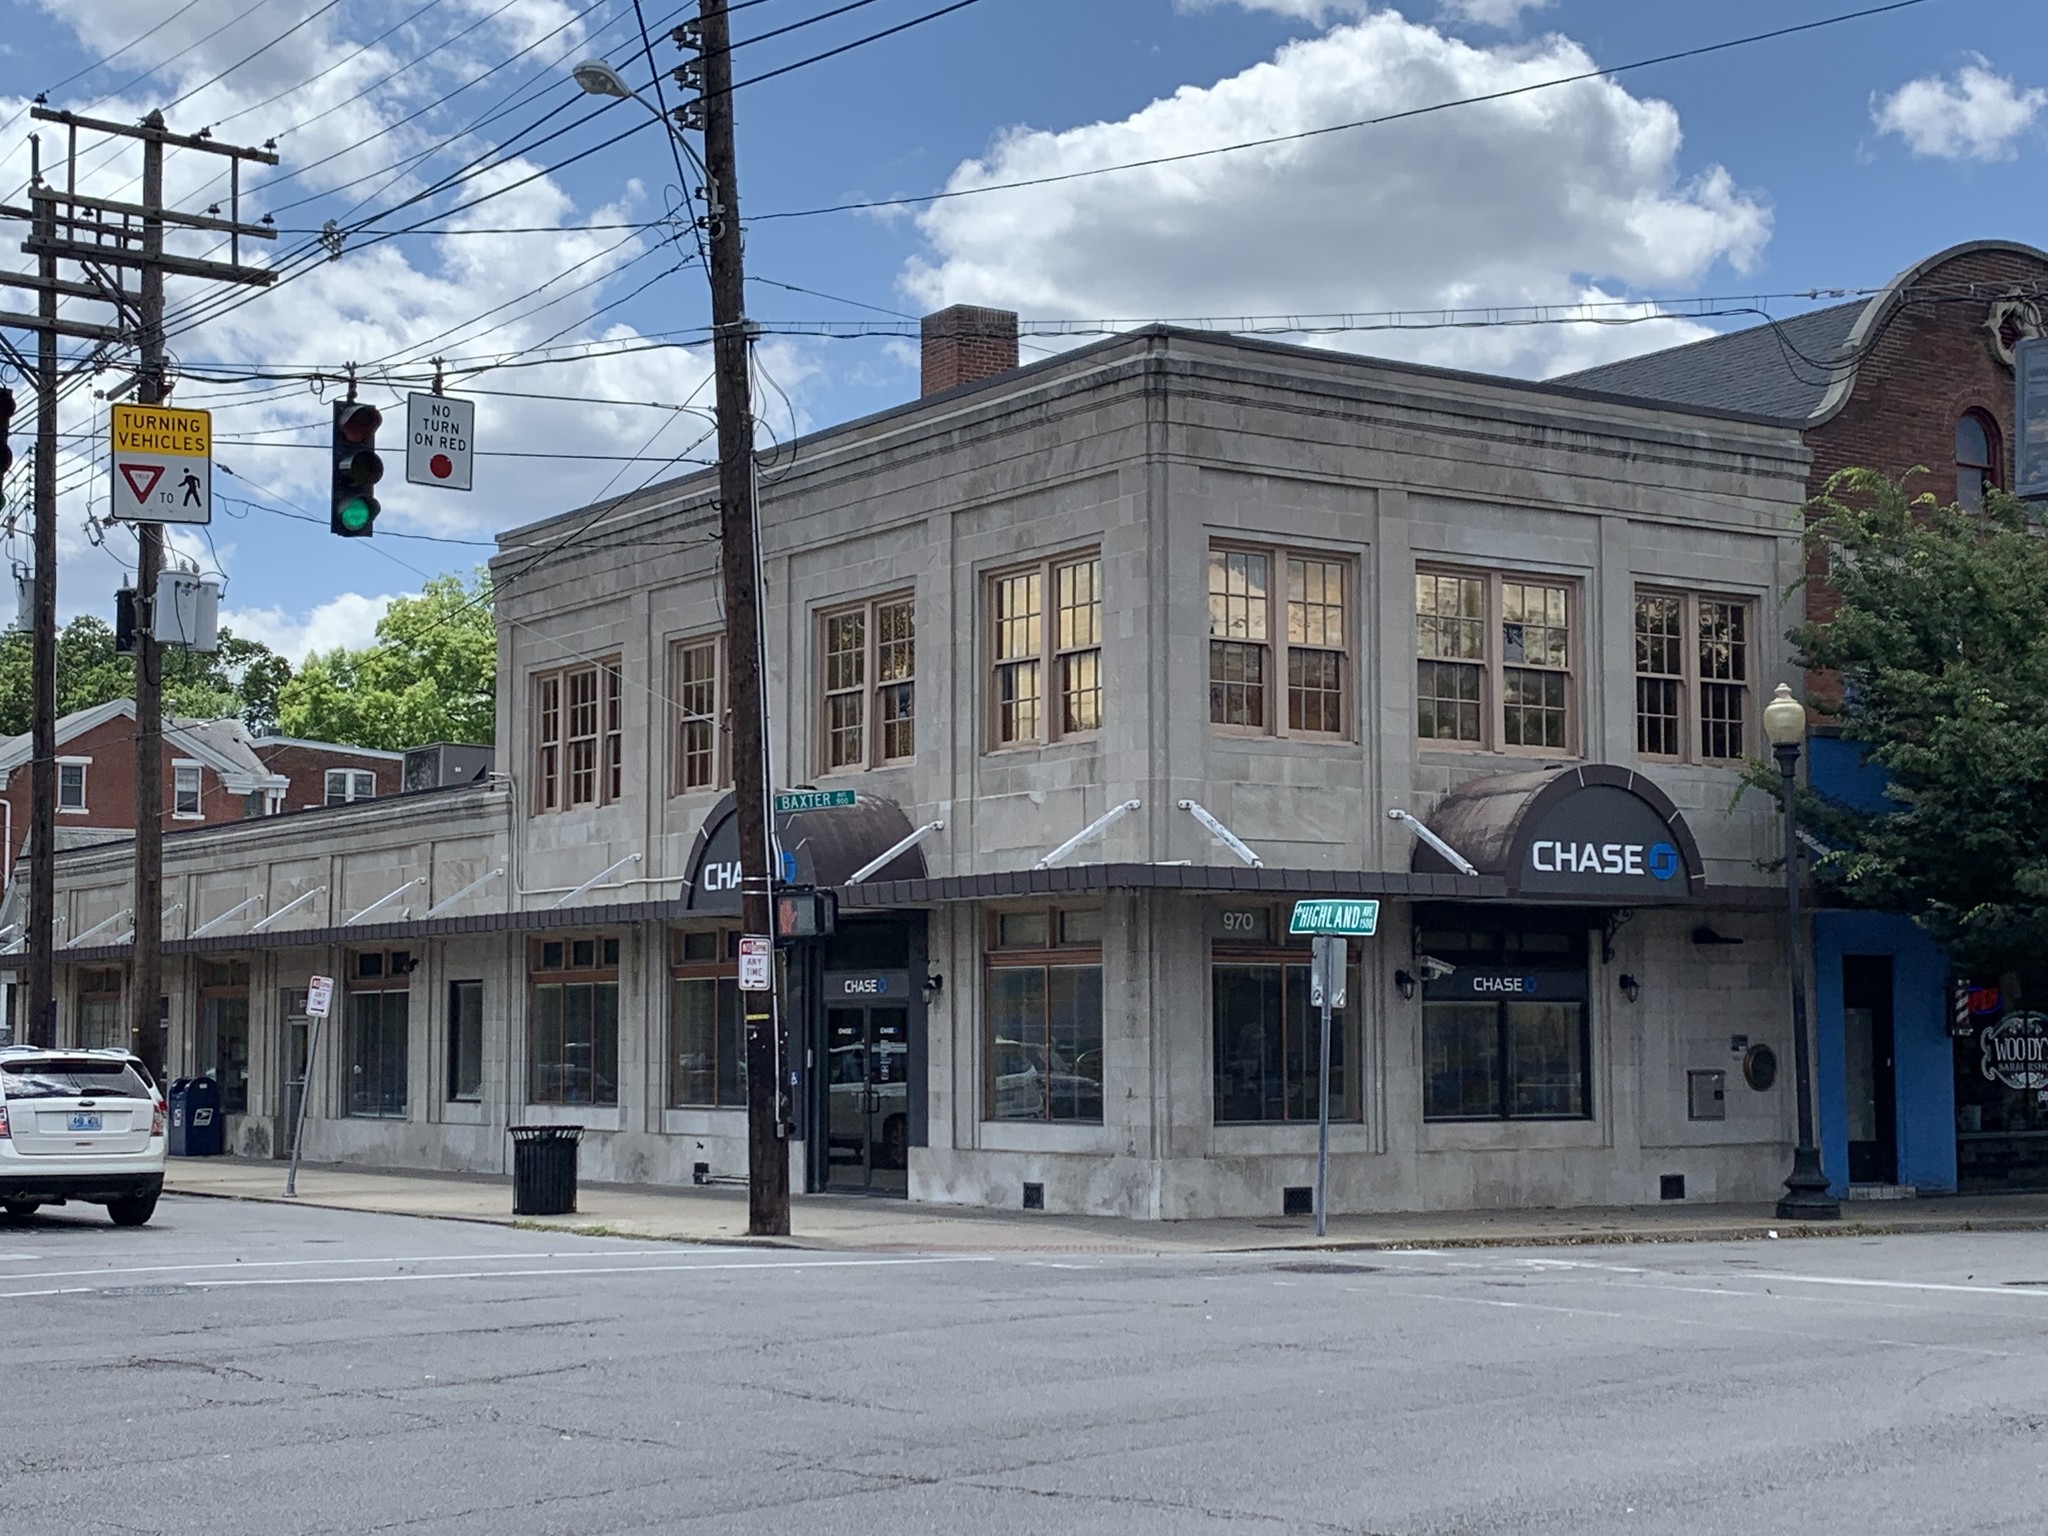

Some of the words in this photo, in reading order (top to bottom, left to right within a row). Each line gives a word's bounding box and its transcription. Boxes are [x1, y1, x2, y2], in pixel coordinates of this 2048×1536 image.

[432, 404, 450, 418] NO
[122, 413, 200, 433] TURNING
[423, 418, 459, 435] TURN
[118, 431, 205, 452] VEHICLES
[415, 432, 433, 447] ON
[440, 436, 466, 451] RED
[160, 492, 174, 504] TO
[781, 792, 831, 810] BAXTER
[1532, 840, 1645, 875] CHASE
[704, 861, 742, 891] CHA
[1223, 912, 1254, 930] 970
[1299, 905, 1361, 929] HIGHLAND
[844, 979, 877, 993] CHASE
[1473, 977, 1523, 993] CHASE
